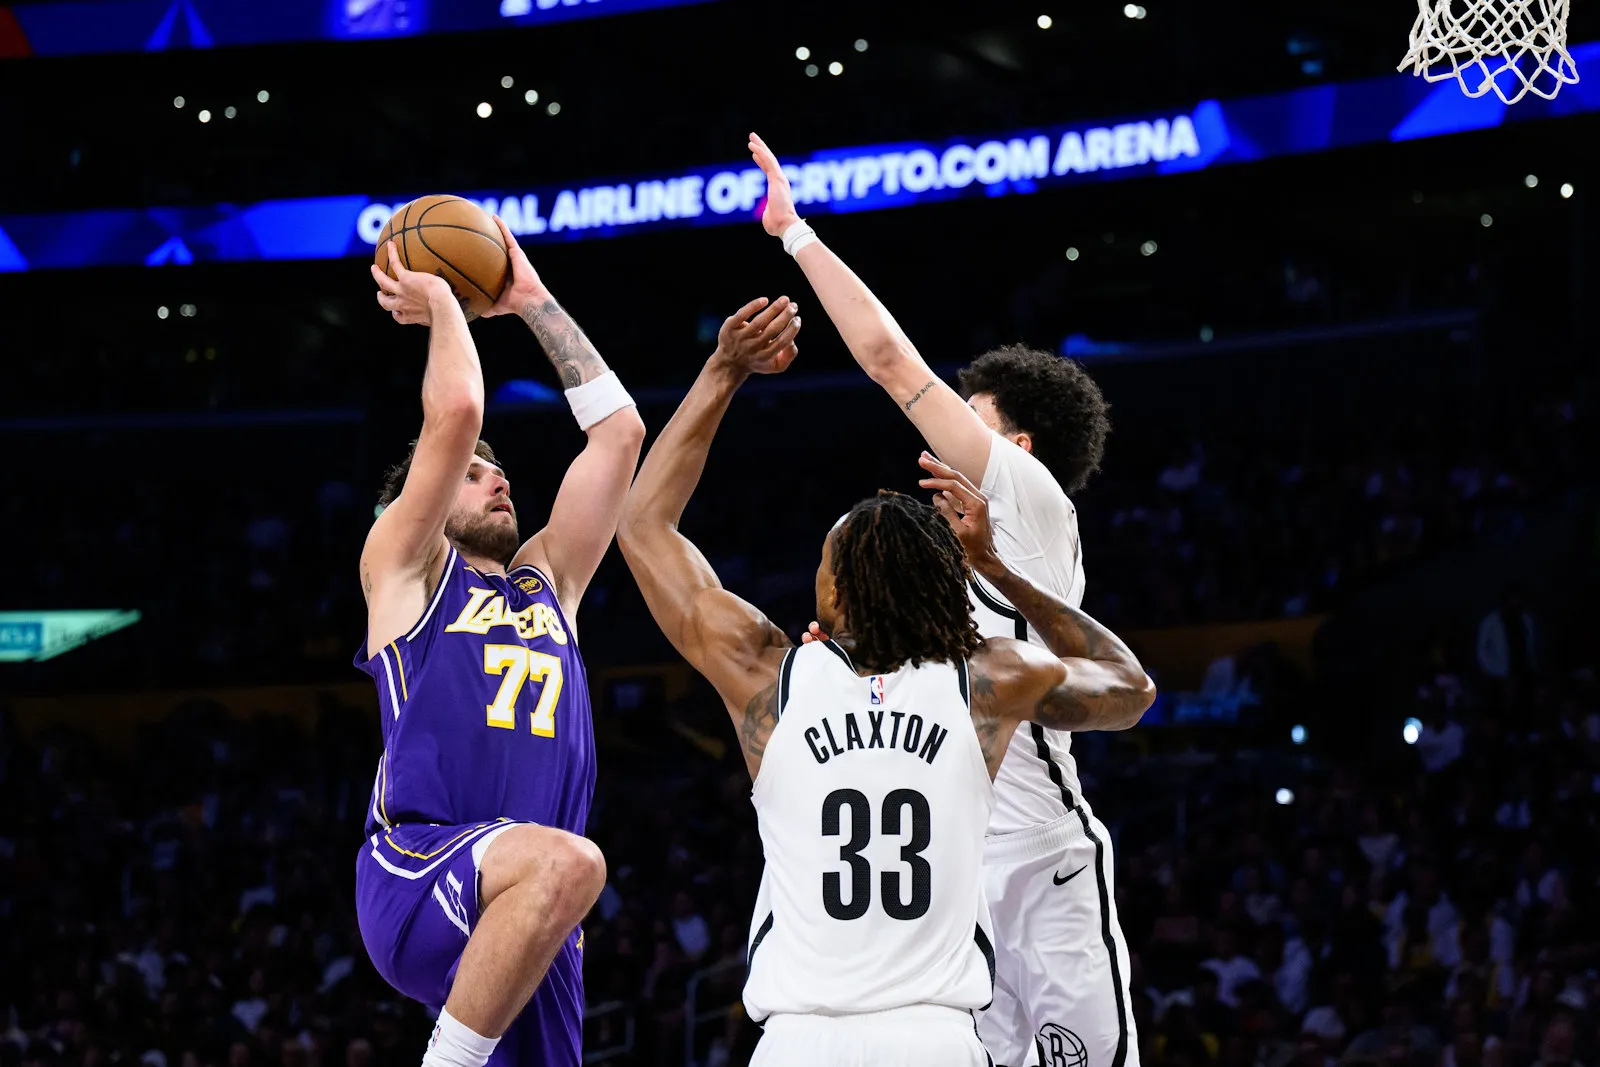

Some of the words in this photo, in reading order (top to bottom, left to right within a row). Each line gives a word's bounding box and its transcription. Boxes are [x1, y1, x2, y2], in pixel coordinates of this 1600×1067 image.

[549, 175, 704, 232] AIRLINE
[705, 168, 767, 214] OF
[1052, 116, 1199, 176] ARENA
[484, 643, 564, 738] 77
[804, 710, 948, 765] CLAXTON
[821, 788, 931, 921] 33
